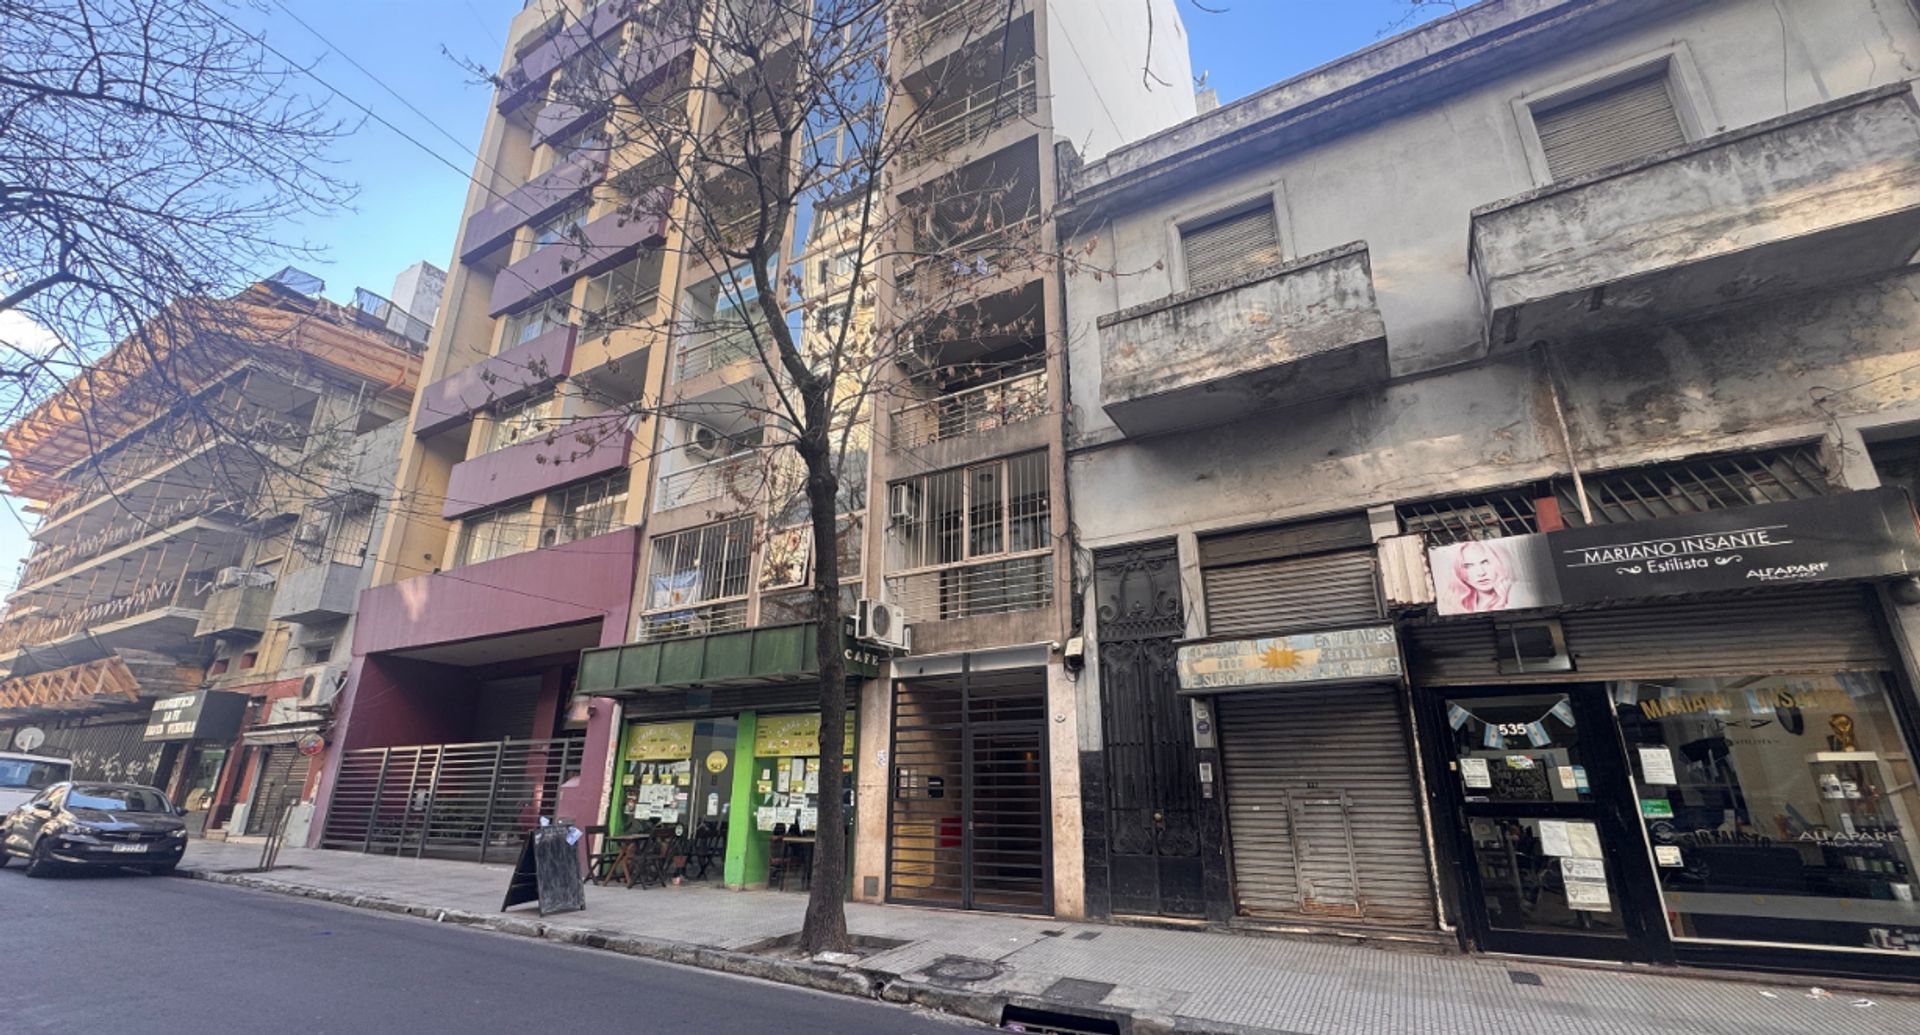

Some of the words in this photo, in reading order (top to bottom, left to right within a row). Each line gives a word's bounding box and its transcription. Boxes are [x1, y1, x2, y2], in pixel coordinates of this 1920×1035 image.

[1584, 543, 1677, 565] MARIANO
[1681, 530, 1770, 554] INSANTE
[1647, 557, 1709, 574] Estilista
[1745, 561, 1829, 579] ALFAPARF
[844, 649, 879, 666] CAFE
[1499, 723, 1527, 736] 535
